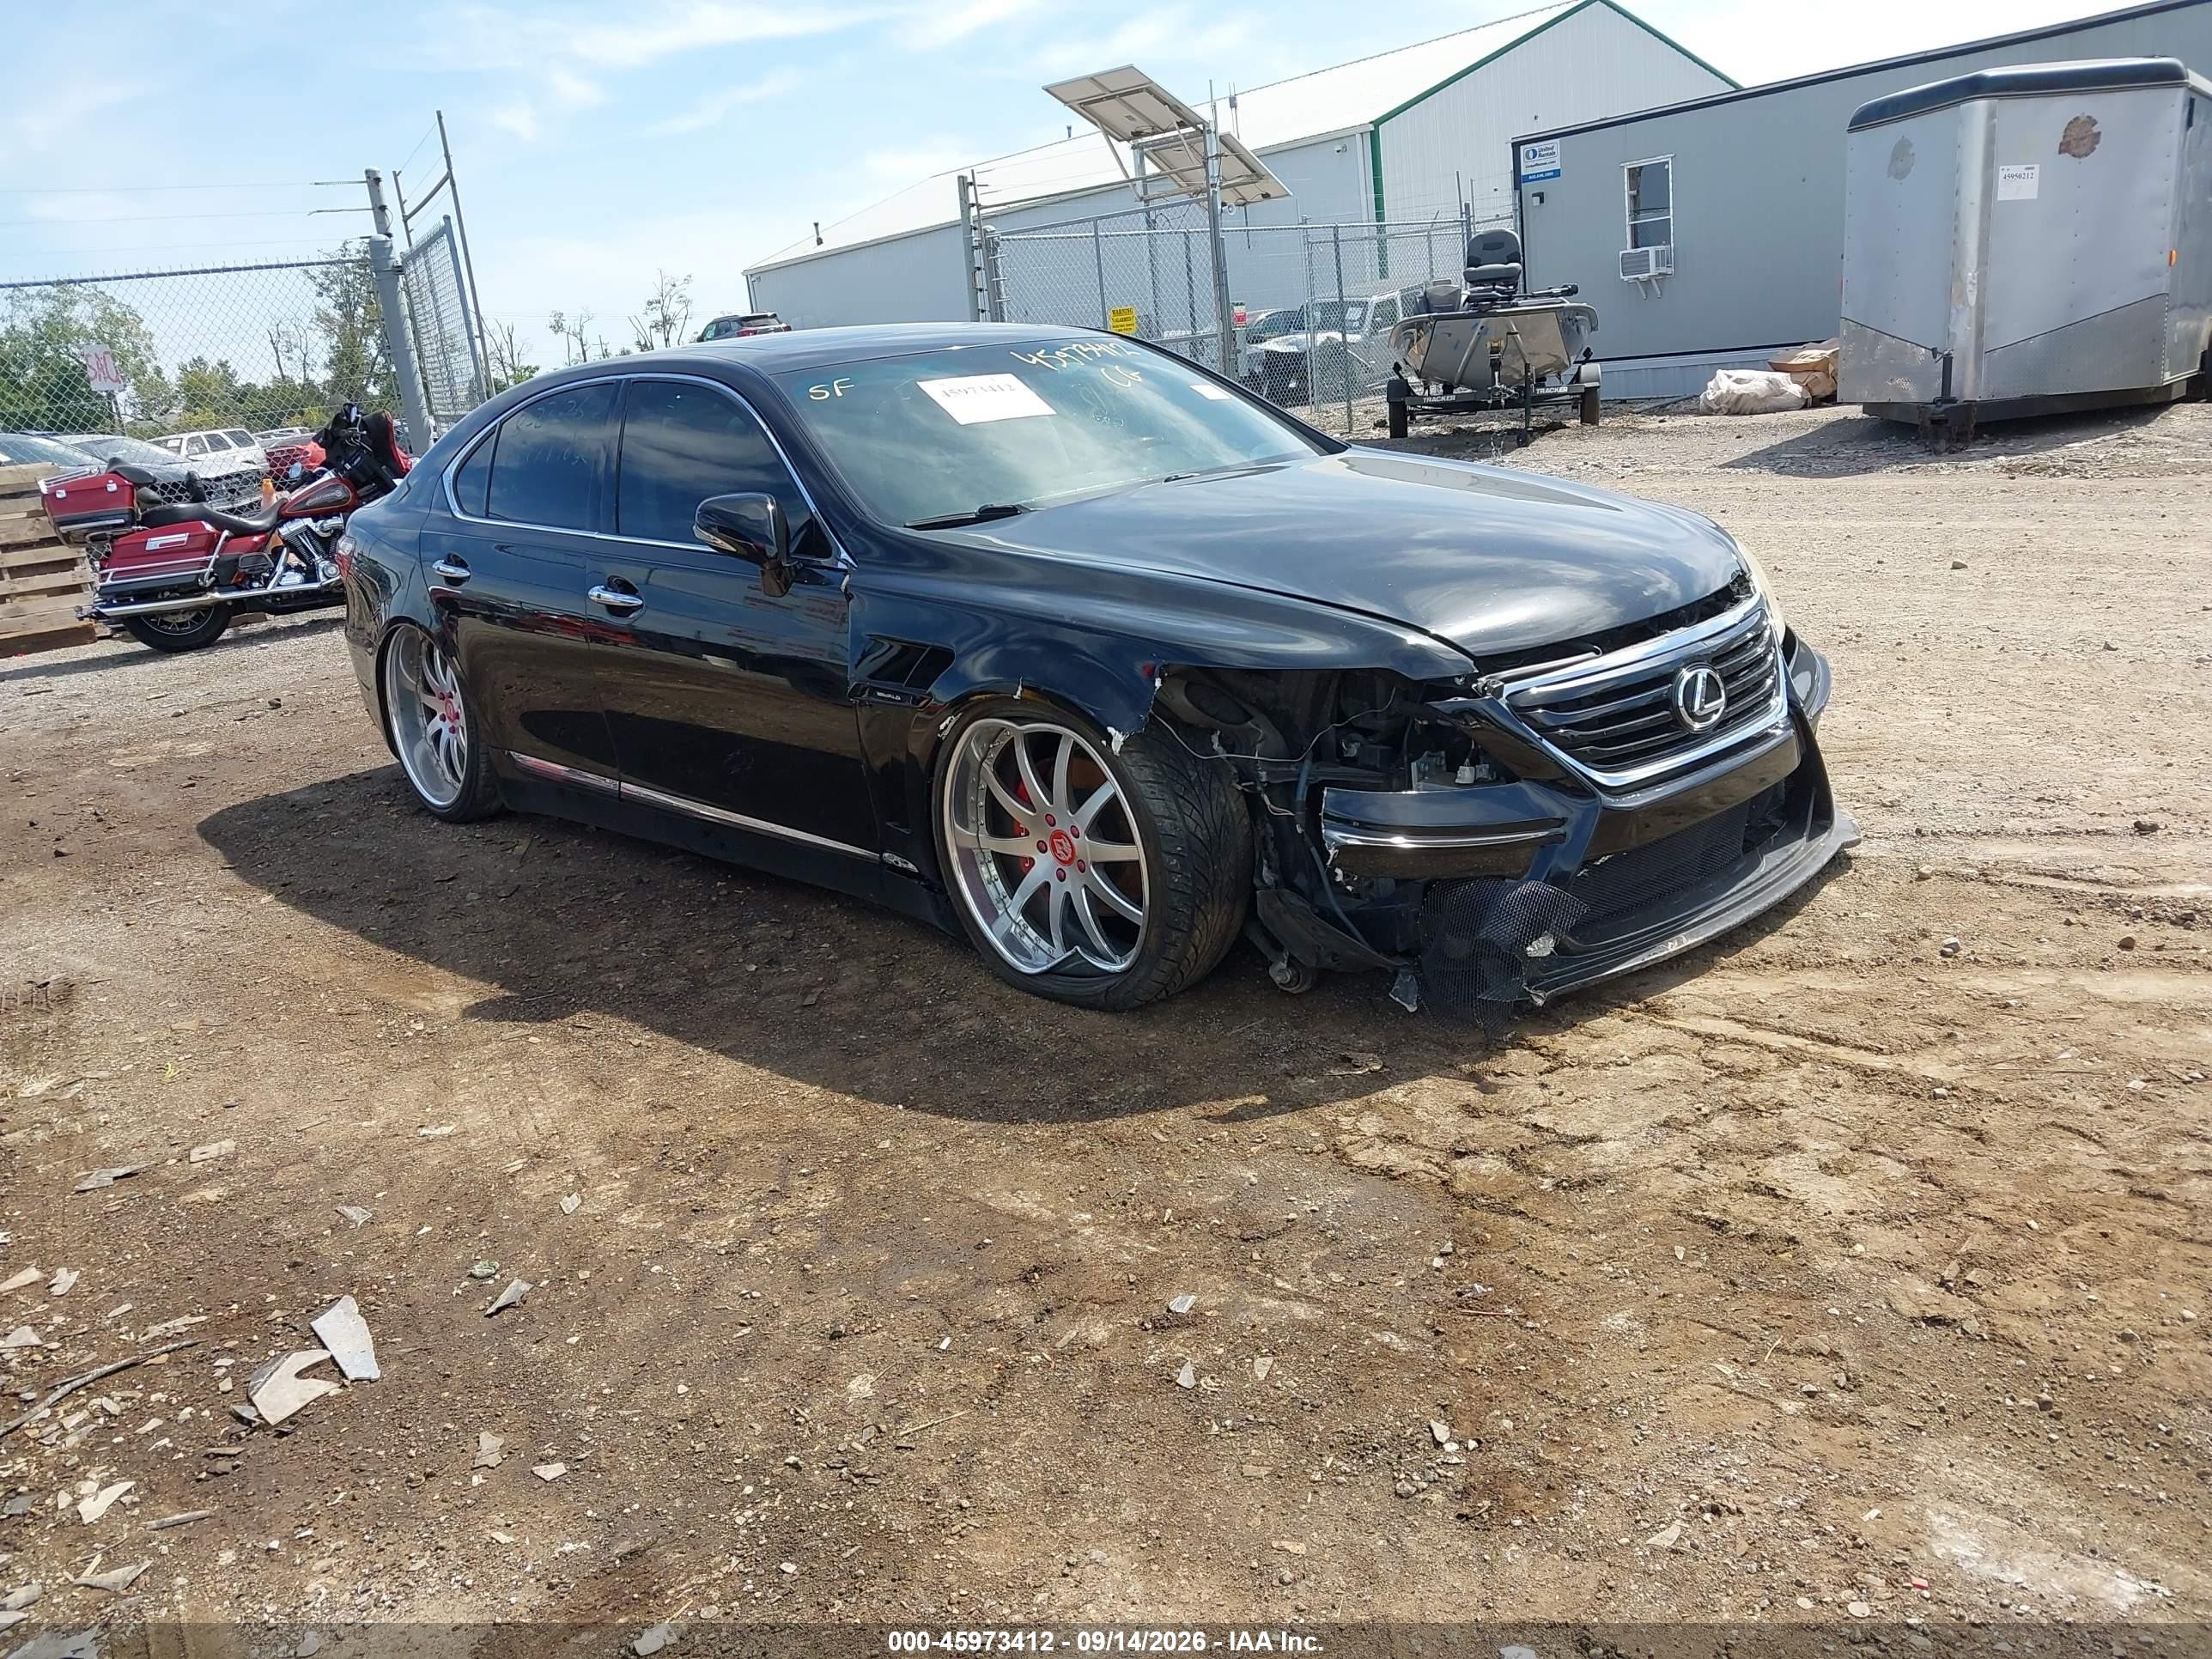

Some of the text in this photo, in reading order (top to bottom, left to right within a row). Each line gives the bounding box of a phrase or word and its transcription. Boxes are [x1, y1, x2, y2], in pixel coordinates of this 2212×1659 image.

[1538, 144, 1555, 153] United
[808, 378, 855, 400] SF
[1536, 386, 1568, 395] TRACKER
[1422, 395, 1456, 404] TRACKER
